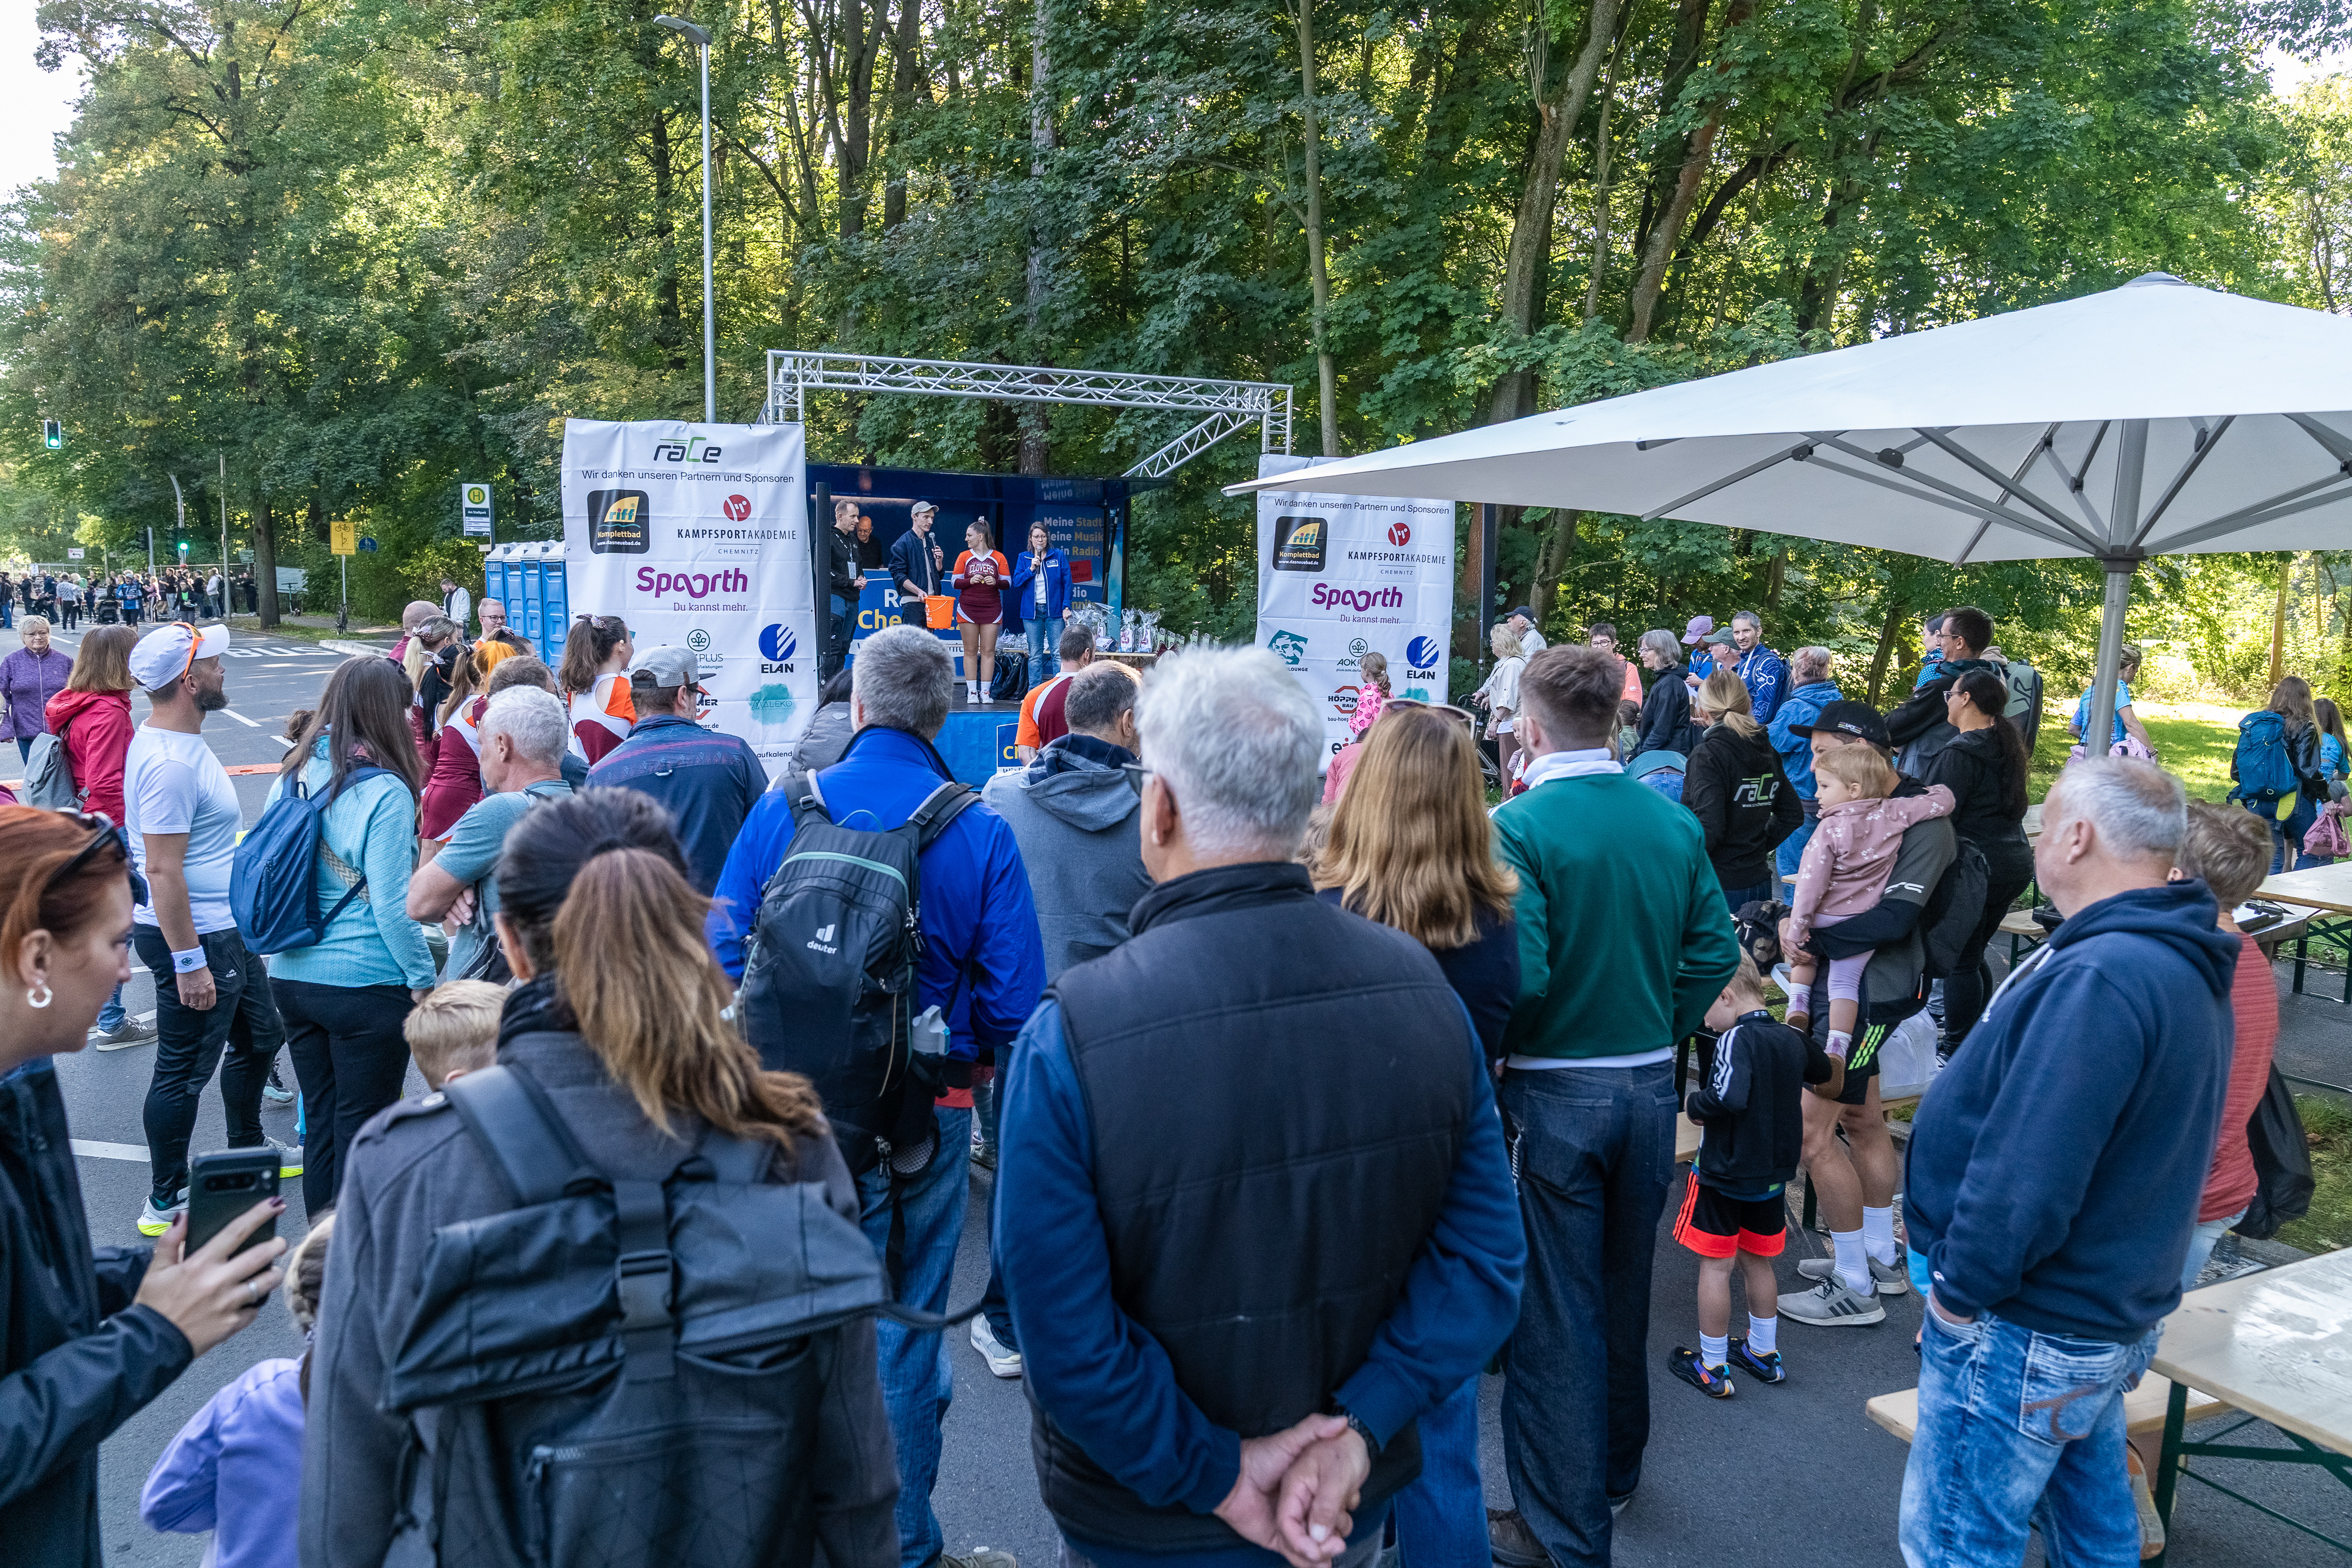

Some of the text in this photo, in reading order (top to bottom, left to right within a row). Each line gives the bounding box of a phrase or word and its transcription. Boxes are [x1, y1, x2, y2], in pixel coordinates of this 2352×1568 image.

[582, 470, 794, 484] Wir danken unseren Partnern und Sponsoren
[1275, 499, 1289, 507] Wir
[1289, 499, 1317, 508] danken
[1354, 502, 1388, 511] Partnern
[1391, 504, 1405, 512] und
[1407, 504, 1449, 514] Sponsoren
[609, 508, 635, 521] riff
[1044, 517, 1102, 527] Meine Stadt
[597, 530, 641, 540] Komplettbad
[677, 529, 797, 540] KAMPFSPORTAKADEMIE
[1048, 531, 1104, 541] eine Musik
[1293, 533, 1316, 544] riff
[1060, 546, 1100, 556] in Radio
[1279, 551, 1319, 559] Komplettbad
[1348, 551, 1446, 565] KAMPFSPORTAKADEMIE
[969, 563, 994, 575] CLOVERS
[1073, 586, 1087, 598] dio
[674, 603, 748, 612] Du kannst mehr.
[1340, 614, 1401, 624] Du kannst mehr.
[223, 647, 340, 658] BUS
[699, 654, 723, 662] PLUS
[761, 663, 794, 674] ELAN
[1406, 670, 1436, 680] ELAN
[1328, 694, 1358, 703] HÖPPN
[807, 940, 837, 955] deuter
